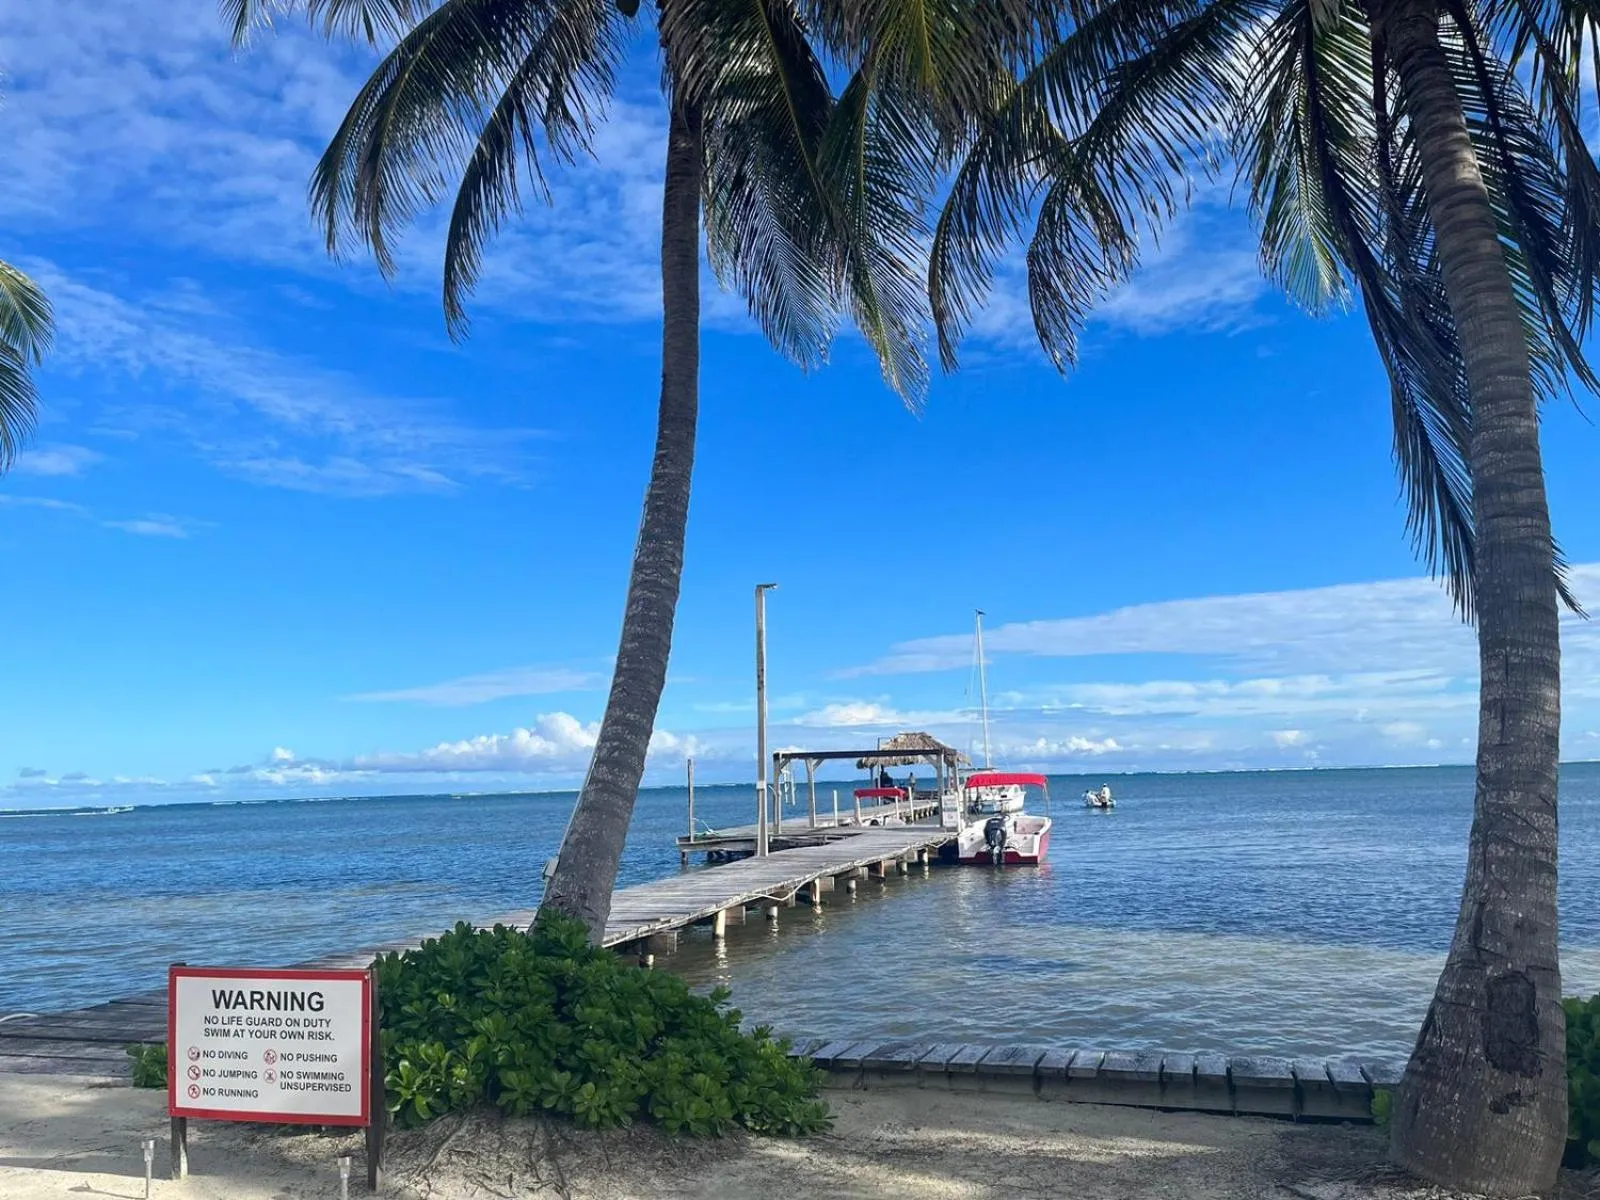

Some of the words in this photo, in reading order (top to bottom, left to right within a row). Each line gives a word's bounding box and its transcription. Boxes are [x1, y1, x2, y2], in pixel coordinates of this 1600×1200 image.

[212, 990, 325, 1012] WARNING
[204, 1016, 219, 1026] NO
[222, 1016, 243, 1026] LIFE
[246, 1017, 282, 1027] GUARD
[285, 1018, 301, 1028] ON
[303, 1018, 332, 1029] DUTY
[204, 1028, 230, 1038] SWIM
[232, 1029, 246, 1039] AT
[248, 1029, 278, 1040] YOUR
[280, 1030, 304, 1041] OWN
[308, 1031, 335, 1042] RISK.
[202, 1050, 216, 1060] NO
[218, 1051, 248, 1060] DIVING
[280, 1053, 294, 1062] NO
[296, 1053, 338, 1064] PUSHING
[202, 1069, 216, 1078] NO
[218, 1070, 258, 1080] JUMPING
[280, 1071, 294, 1080] NO
[296, 1071, 345, 1081] SWIMMING
[280, 1082, 352, 1093] UNSUPERVISED
[202, 1088, 216, 1097] NO
[218, 1088, 259, 1099] RUNNING
